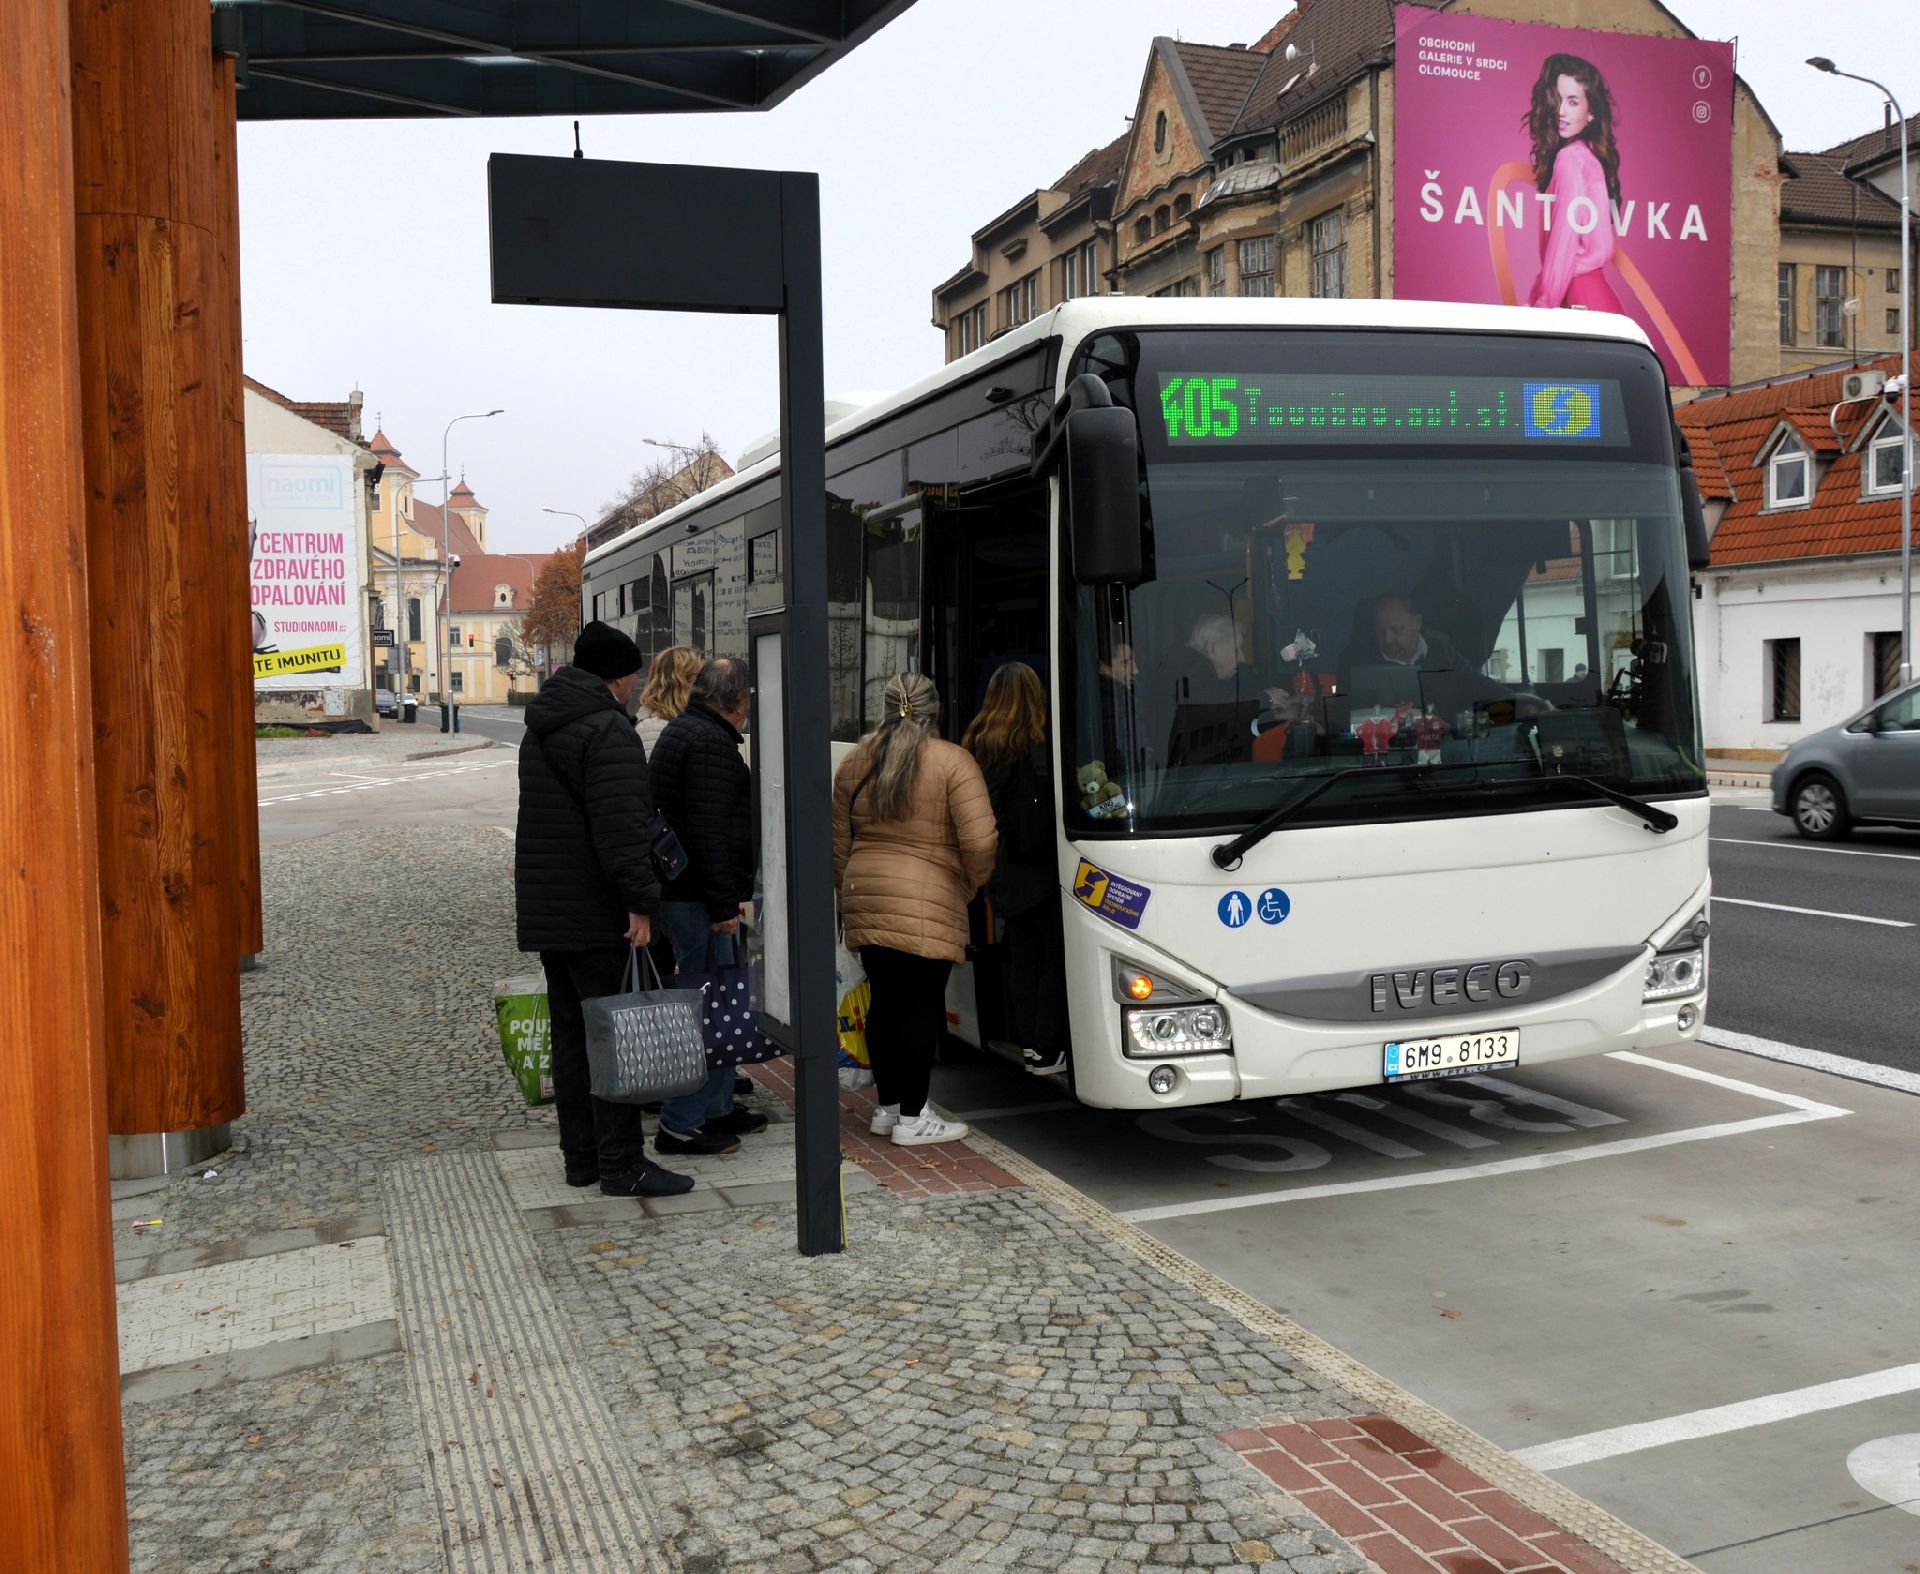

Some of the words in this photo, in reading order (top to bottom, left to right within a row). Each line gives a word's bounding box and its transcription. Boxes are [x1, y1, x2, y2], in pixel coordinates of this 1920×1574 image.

[1419, 36, 1475, 53] OBCHODNÍ
[1419, 50, 1463, 65] GALERIE
[1466, 56, 1473, 66] V
[1476, 57, 1507, 71] SRDCI
[1418, 64, 1481, 80] OLOMOUCE
[1419, 169, 1708, 241] ŠANTOVKA
[1160, 377, 1239, 437] 405
[266, 475, 334, 494] naomi
[260, 532, 344, 554] CENTRUM
[253, 555, 345, 580] ZDRAVÉHO
[250, 582, 346, 606] OPALOVÁNÍ
[278, 649, 341, 668] IMUNITU
[1371, 960, 1531, 1013] IVECO
[523, 1055, 534, 1069] A
[1405, 1044, 1442, 1068] 6M9
[1459, 1036, 1508, 1062] 8133
[1387, 1063, 1398, 1071] CZ
[1410, 1064, 1495, 1080] WWW.FTL.CZ
